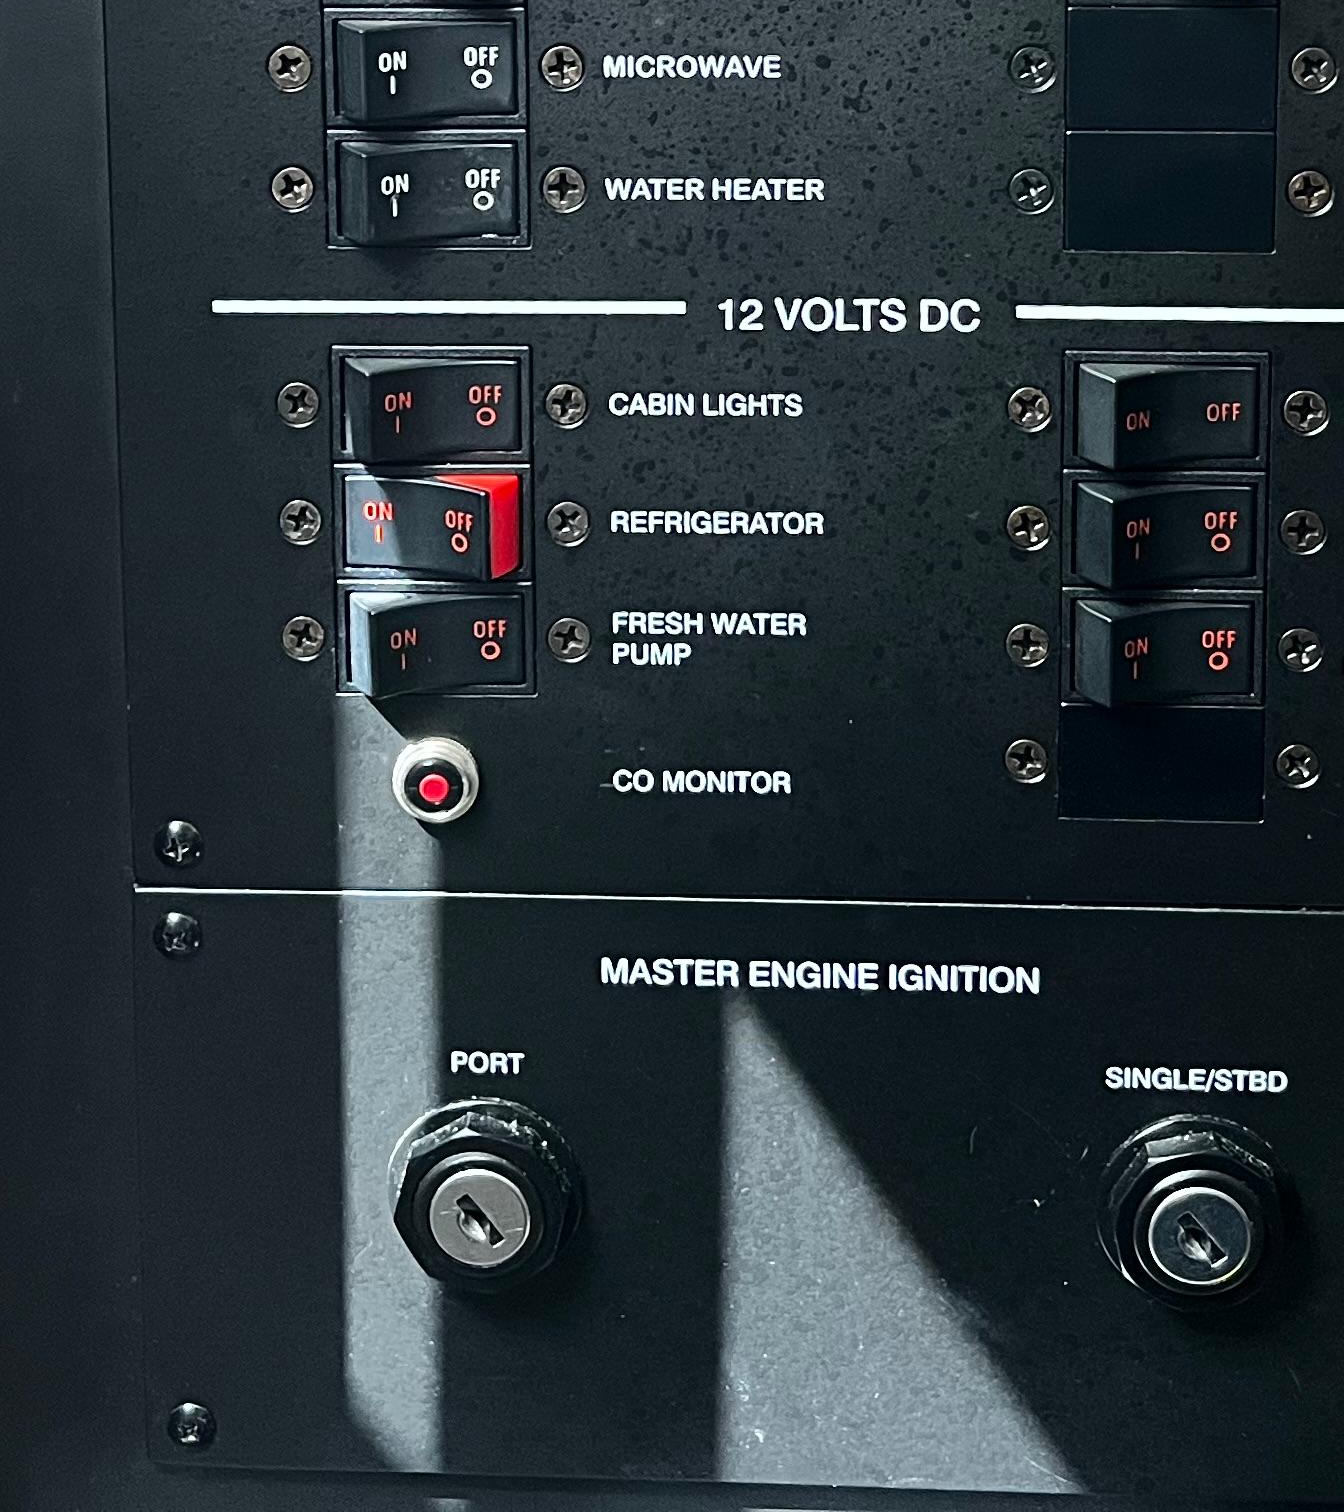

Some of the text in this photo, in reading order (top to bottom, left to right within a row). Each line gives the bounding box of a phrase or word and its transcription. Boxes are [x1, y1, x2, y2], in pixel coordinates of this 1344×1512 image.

[378, 50, 407, 73] ON
[463, 46, 499, 67] OFF
[602, 54, 782, 79] MICROWAVE
[380, 173, 409, 198] ON
[464, 168, 501, 189] OFF
[604, 177, 825, 201] WATER HEATER
[717, 296, 981, 333] 12 VOLTS DC
[384, 391, 412, 413] ON
[468, 385, 502, 405] OFF
[608, 392, 804, 417] CABIN LIGHTS
[1126, 411, 1150, 431] ON
[1206, 402, 1241, 422] OFF
[362, 500, 393, 524] ON
[445, 510, 473, 533] OFF
[610, 510, 825, 535] REFRIGERATOR
[1204, 511, 1238, 530] OFF
[1126, 518, 1150, 539] ON
[473, 619, 506, 639] OFF
[612, 610, 807, 637] FRESH WATER
[390, 627, 417, 650] ON
[1124, 637, 1149, 658] ON
[1201, 630, 1236, 649] OFF
[612, 642, 692, 666] PUMP
[612, 768, 792, 795] CO MONITOR
[600, 956, 1040, 995] MASTER ENGINE IGNITION
[450, 1050, 526, 1075] PORT
[1104, 1066, 1289, 1093] SINGLE/STBD
